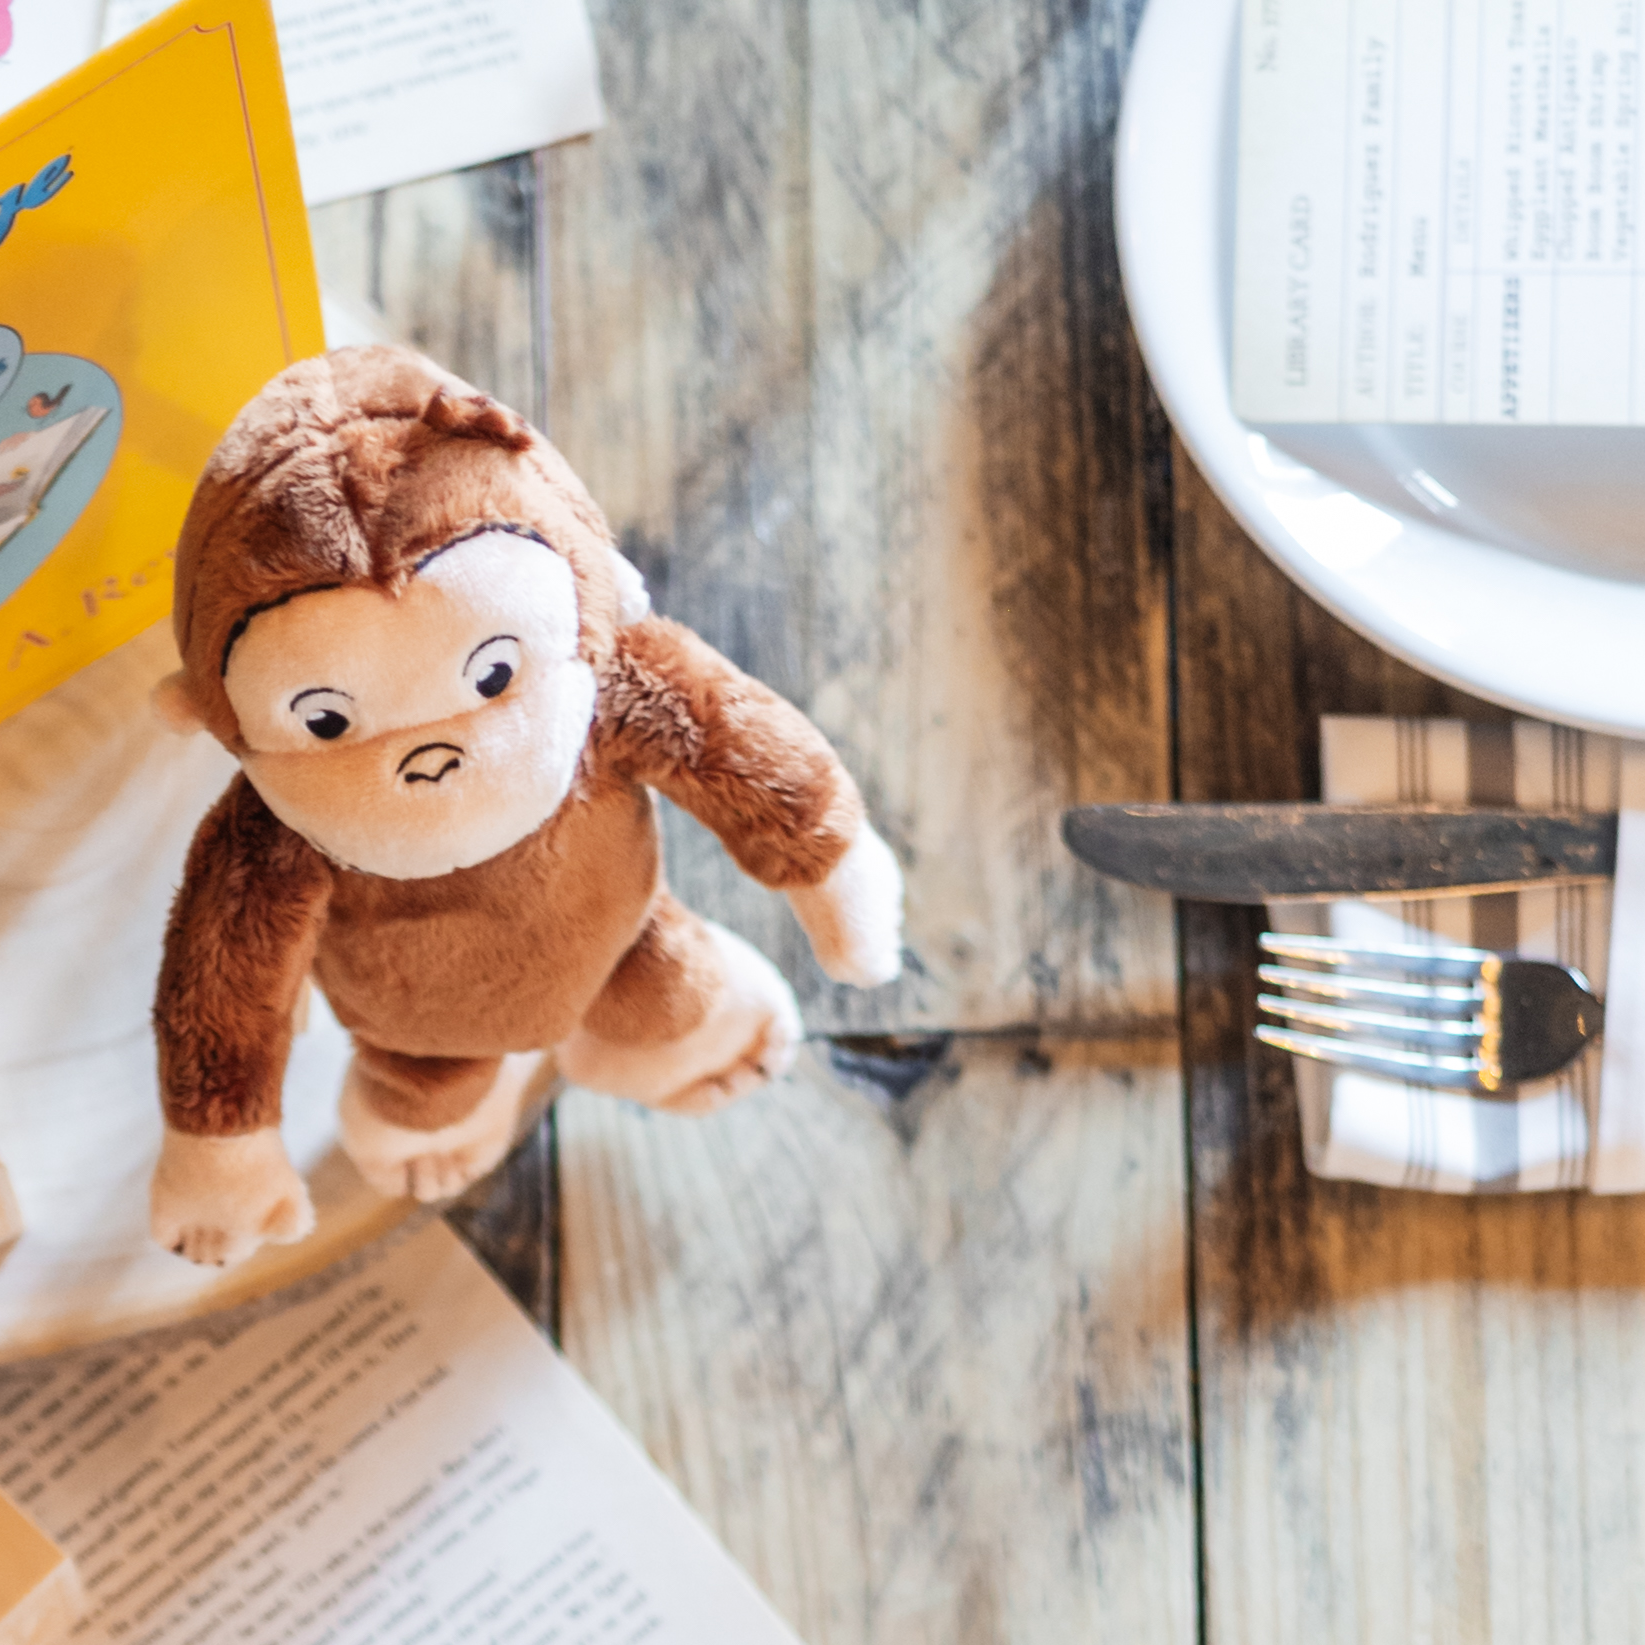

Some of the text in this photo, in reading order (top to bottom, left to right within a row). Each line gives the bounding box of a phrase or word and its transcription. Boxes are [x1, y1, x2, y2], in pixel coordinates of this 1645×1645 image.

[1505, 0, 1527, 50] Toas
[1359, 34, 1388, 128] Family
[1406, 214, 1429, 278] Menu
[1501, 165, 1526, 263] Whipped
[1282, 192, 1313, 388] LIBRARY CARD
